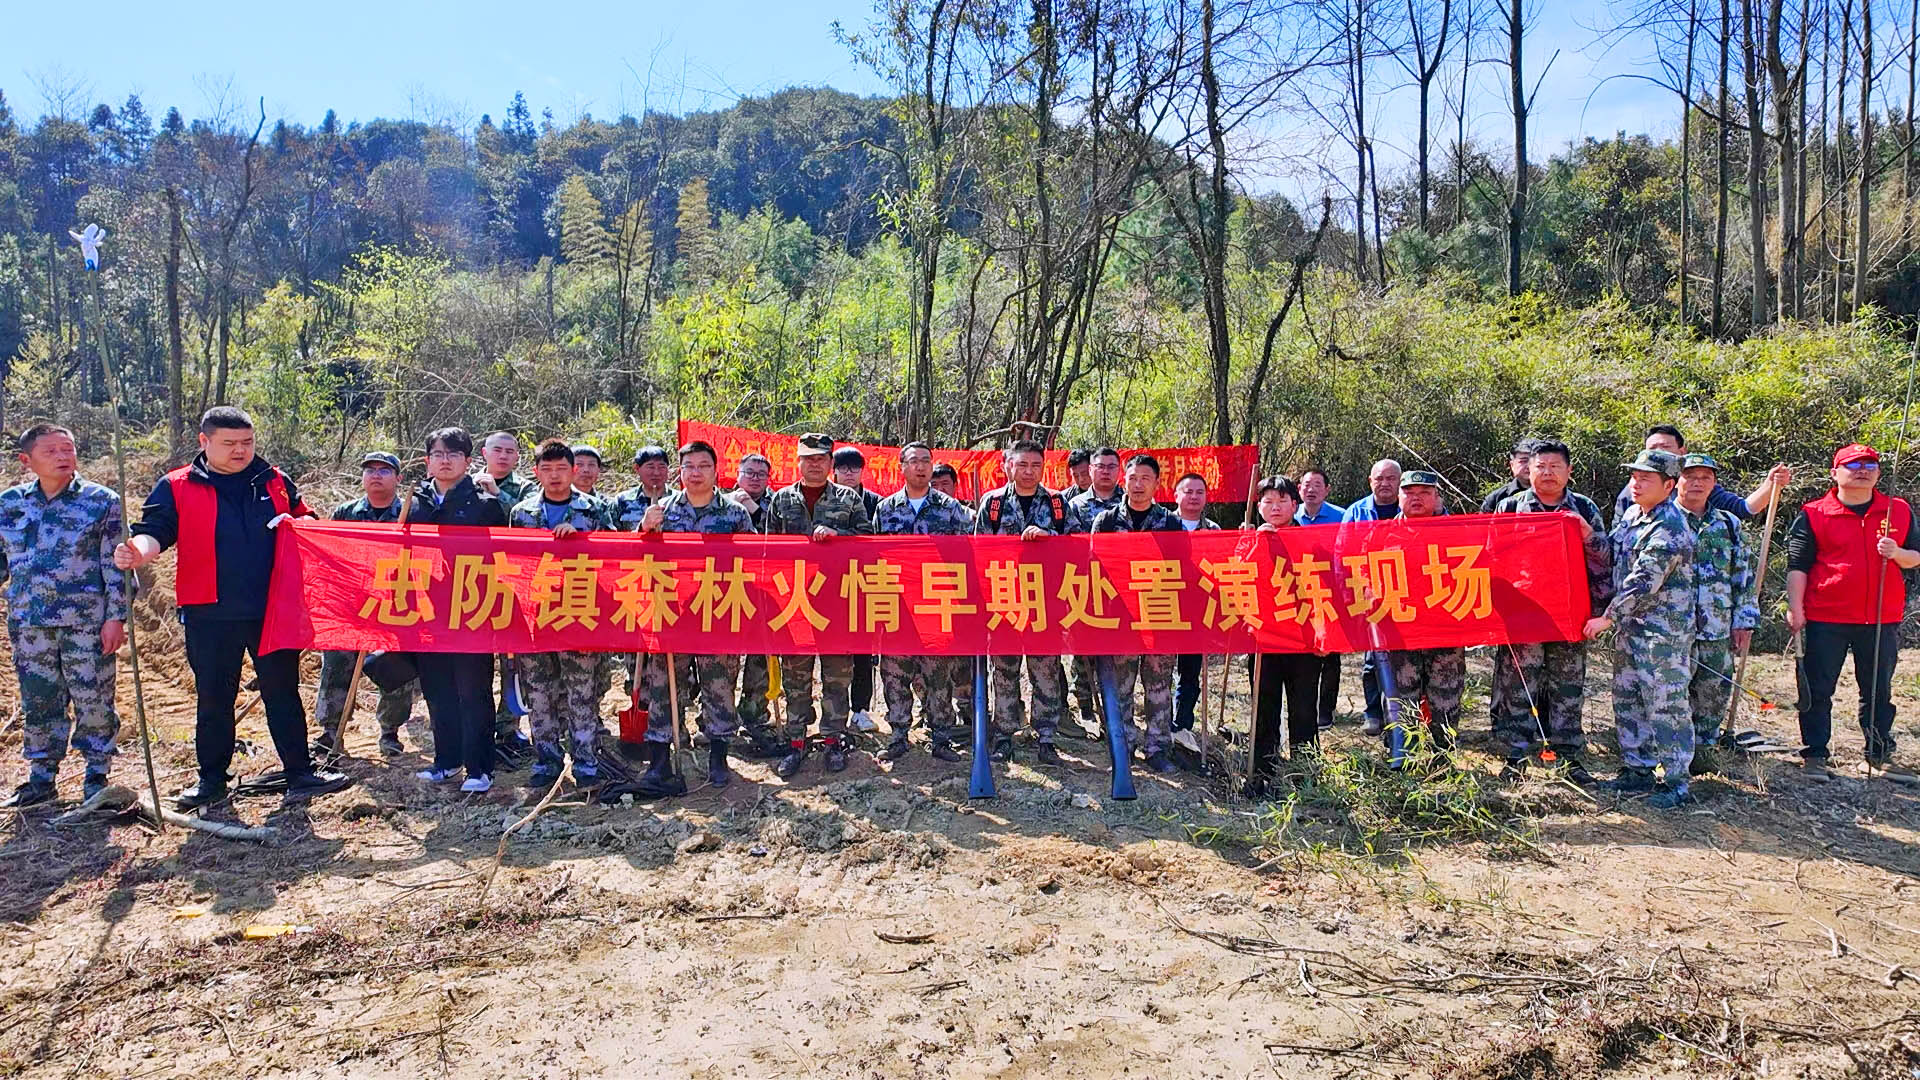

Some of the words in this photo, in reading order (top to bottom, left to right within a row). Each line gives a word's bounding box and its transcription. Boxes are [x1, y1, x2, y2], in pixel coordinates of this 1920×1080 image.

[360, 544, 1493, 633] 忠防镇森林火情早期处置演练现场
